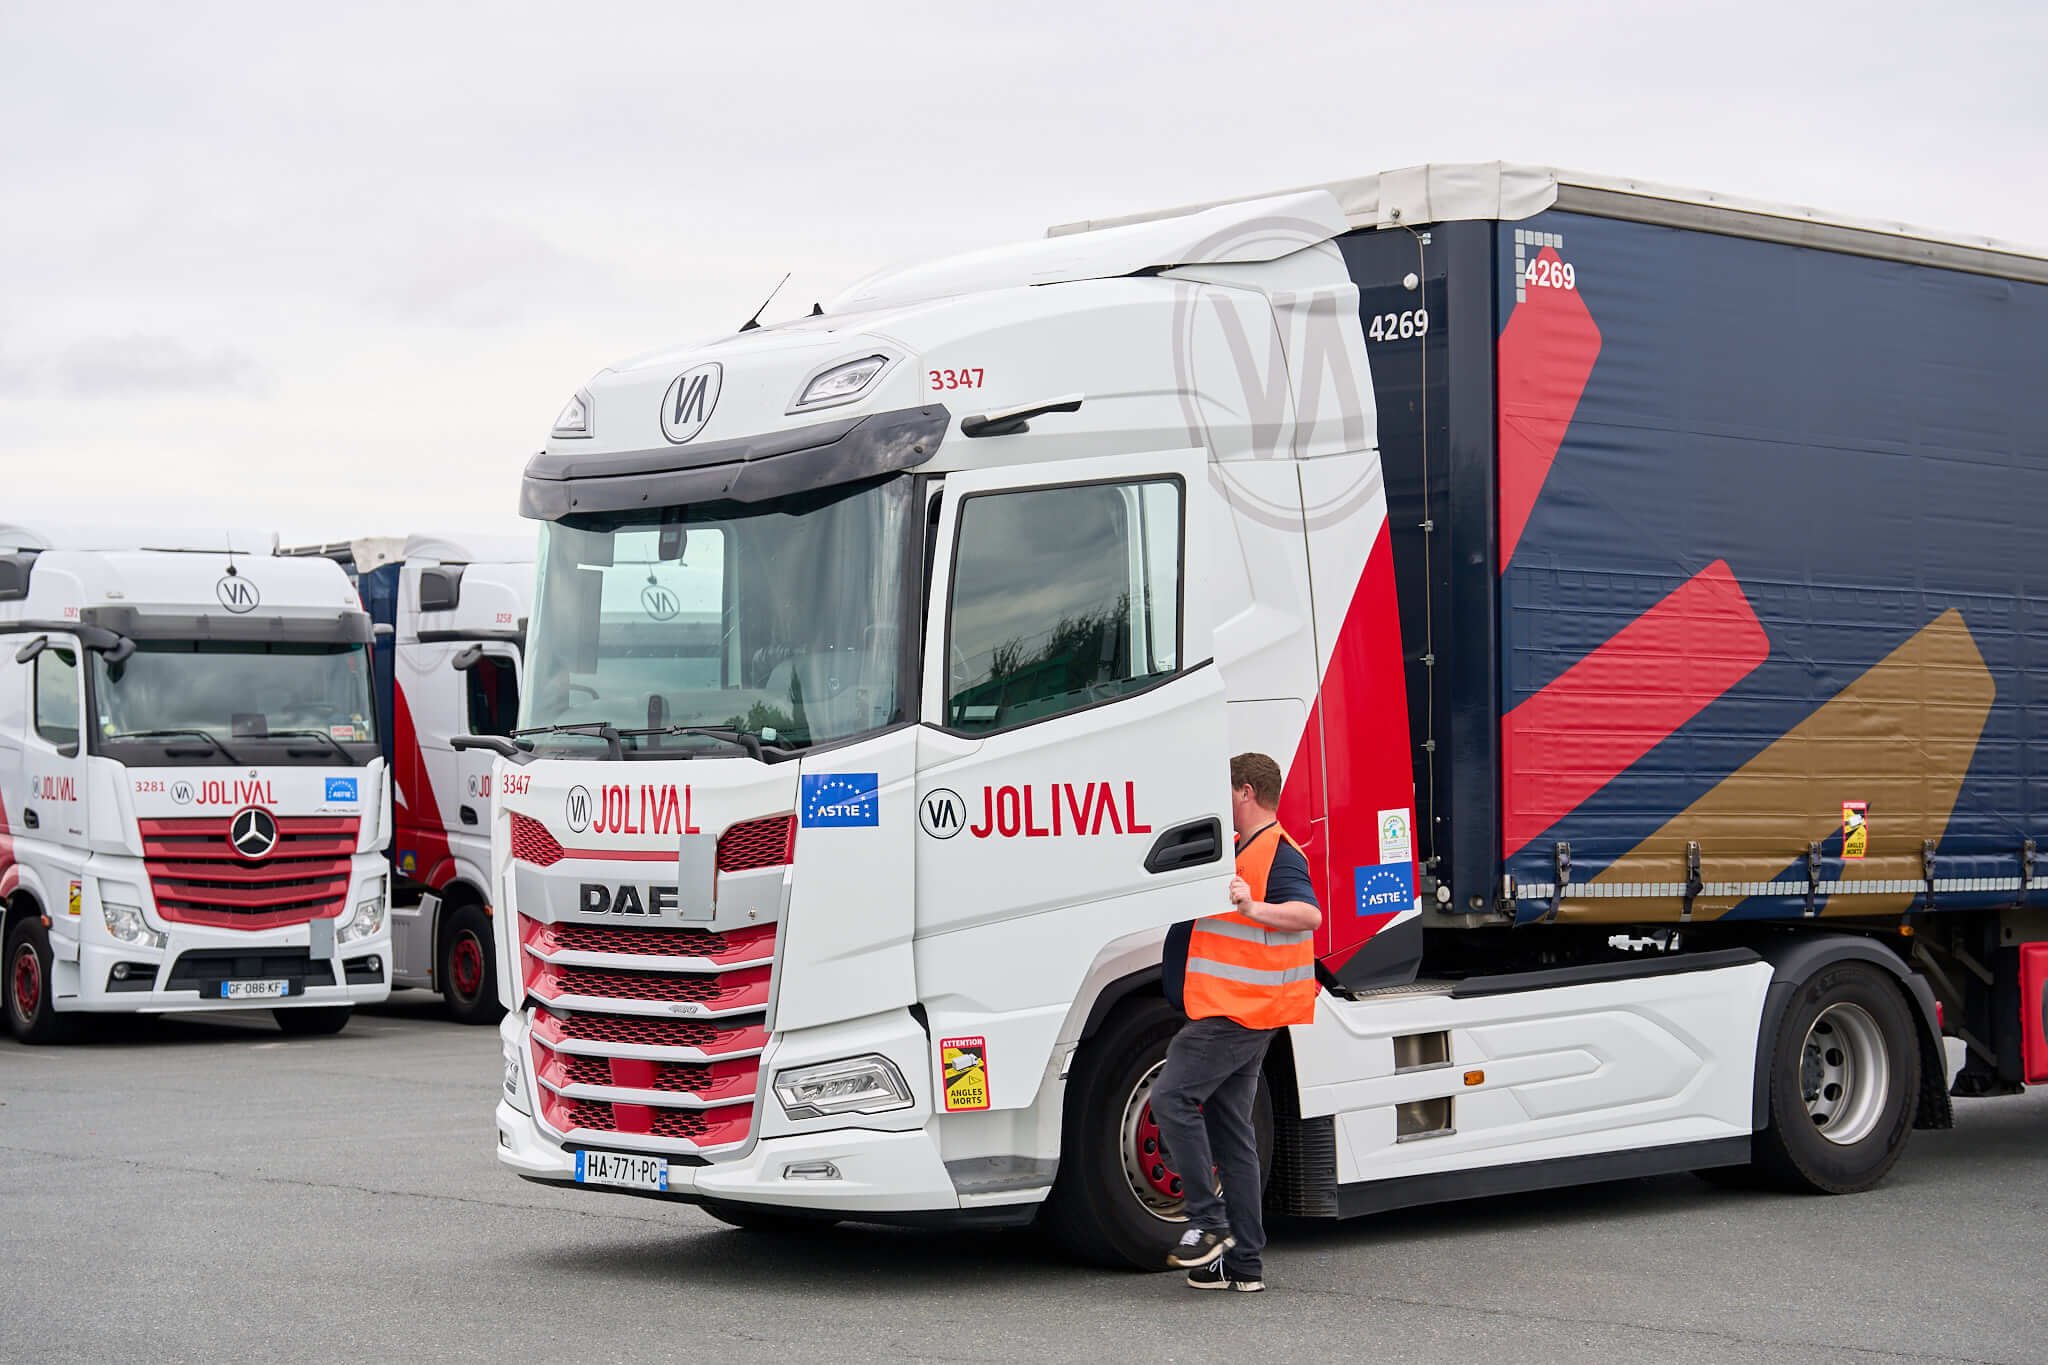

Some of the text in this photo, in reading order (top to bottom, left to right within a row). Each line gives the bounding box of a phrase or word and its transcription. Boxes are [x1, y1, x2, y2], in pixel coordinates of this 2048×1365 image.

[1524, 258, 1576, 290] 4269
[1368, 309, 1430, 342] 4269
[929, 367, 985, 391] 3347
[136, 779, 165, 792] 3281
[196, 781, 278, 804] JOLIVAL
[503, 774, 531, 794] 3347
[593, 784, 701, 835] JOLIVAL
[817, 804, 861, 817] ASTRE
[970, 781, 1152, 838] JOLIVAL
[580, 883, 679, 917] DAF
[1369, 891, 1400, 905] ASTRE
[943, 1039, 983, 1048] ATTENTION
[951, 1089, 983, 1097] ANGLES
[953, 1097, 982, 1105] MORTS
[588, 1154, 657, 1183] HA-771-PC
